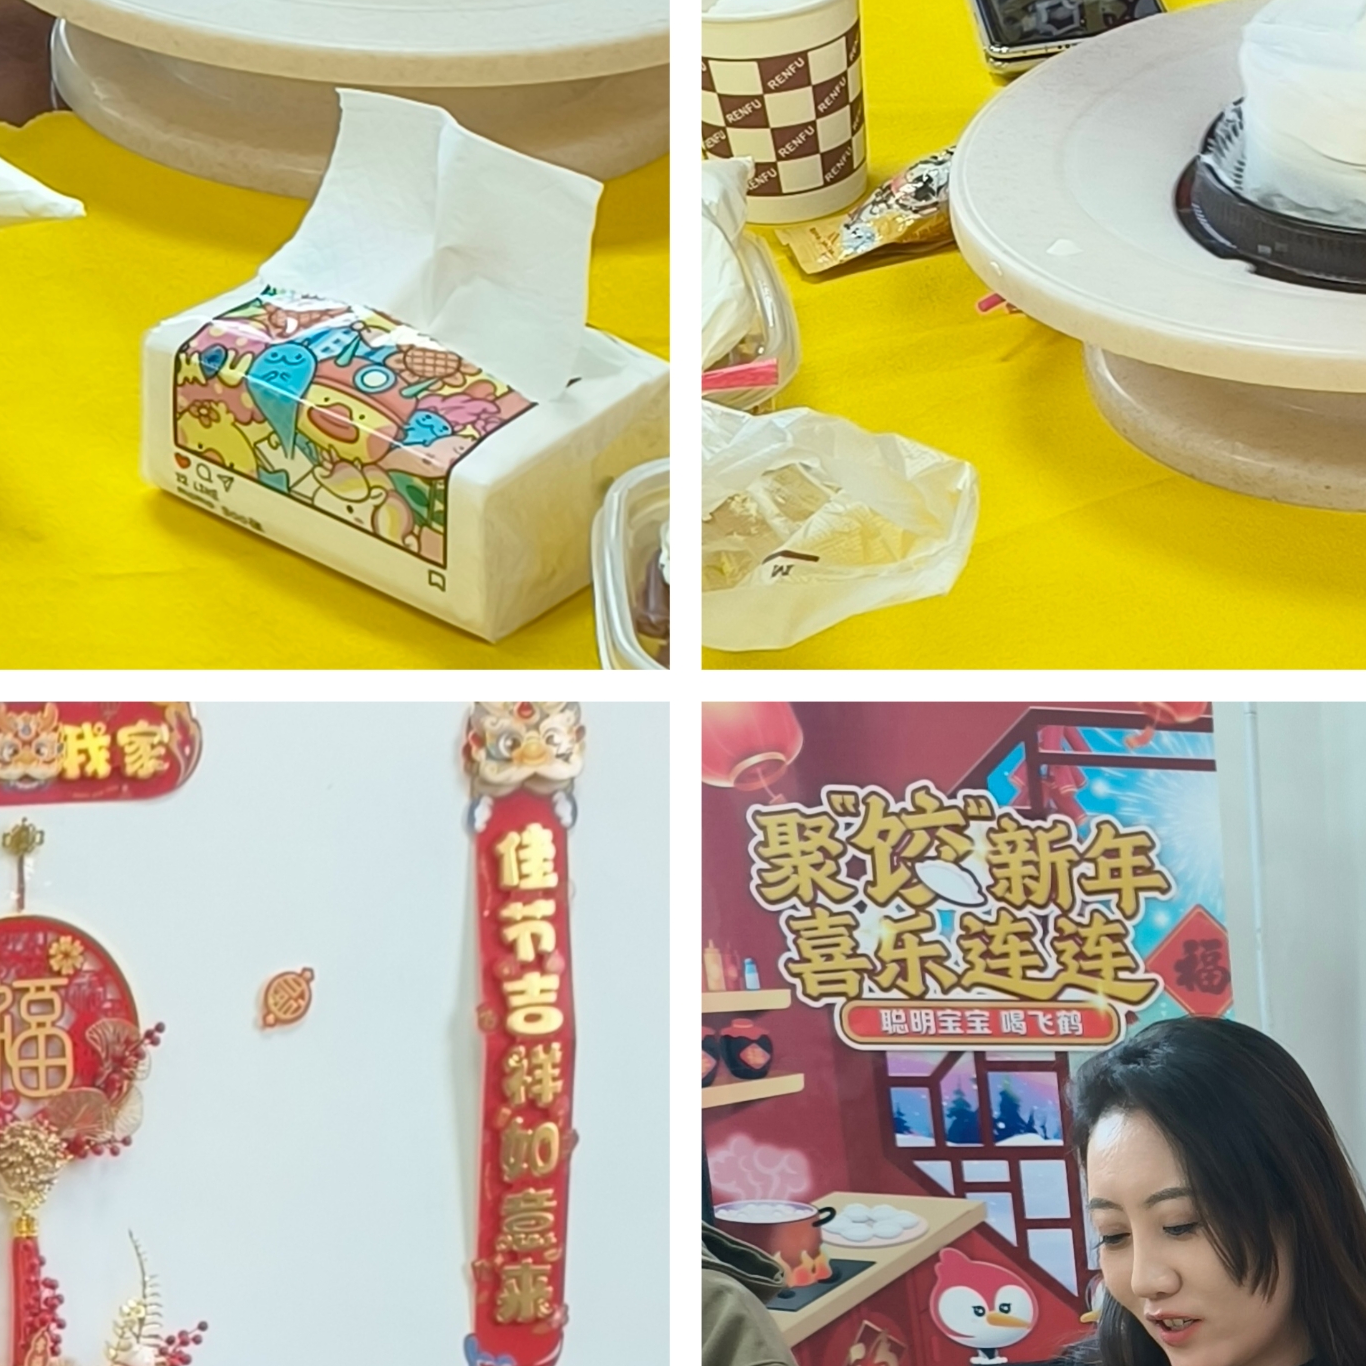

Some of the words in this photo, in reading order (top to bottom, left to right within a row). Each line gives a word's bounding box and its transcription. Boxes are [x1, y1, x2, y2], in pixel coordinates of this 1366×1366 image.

[767, 57, 805, 91] RENFU
[725, 98, 763, 124] RENFU
[817, 76, 847, 114] RENFU
[778, 125, 816, 158] RENFU
[824, 146, 853, 183] RENFU
[785, 906, 1160, 1006] 喜乐连连
[1173, 938, 1231, 996] 福
[879, 1008, 993, 1038] 聪明宝宝
[1001, 1009, 1084, 1038] 喝飞鹤
[494, 822, 564, 1325] 佳节吉祥如意来
